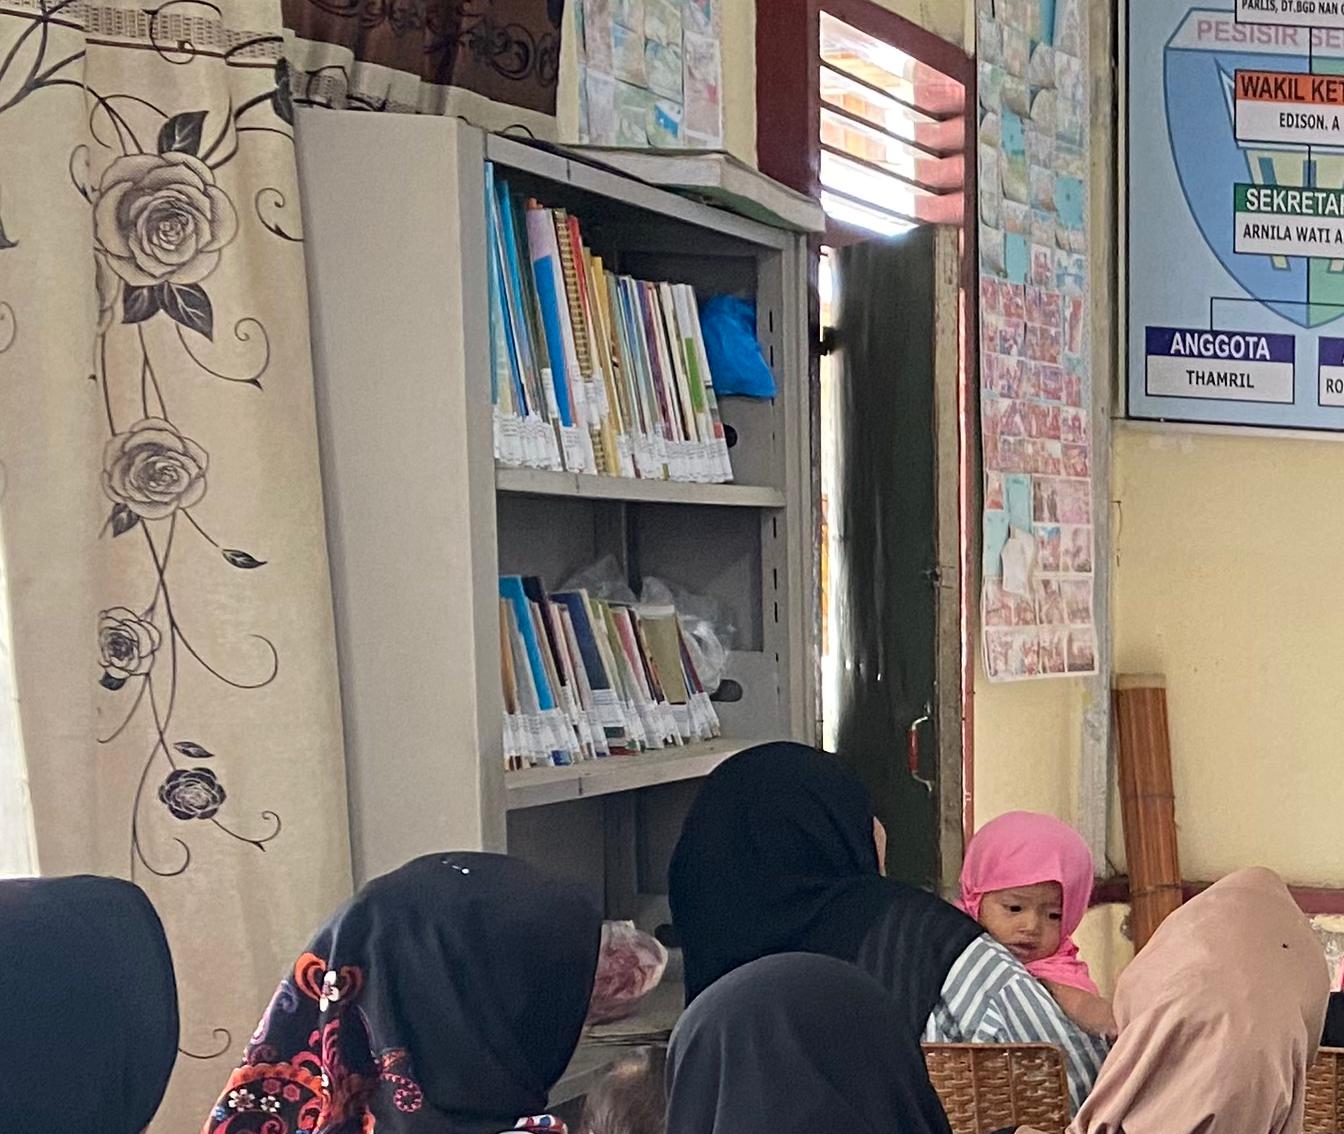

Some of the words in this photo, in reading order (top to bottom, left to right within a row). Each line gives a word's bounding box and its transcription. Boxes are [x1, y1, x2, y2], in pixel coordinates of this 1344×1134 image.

[1318, 3, 1338, 15] NAN
[1197, 19, 1299, 46] PESISIR
[1241, 75, 1304, 101] WAKIL
[1279, 112, 1328, 131] EDISON.
[1332, 115, 1340, 131] A
[1243, 223, 1292, 242] ARNILA
[1296, 226, 1330, 243] WATI
[1169, 331, 1272, 361] ANGGOTA
[1186, 369, 1255, 390] THAMRIL
